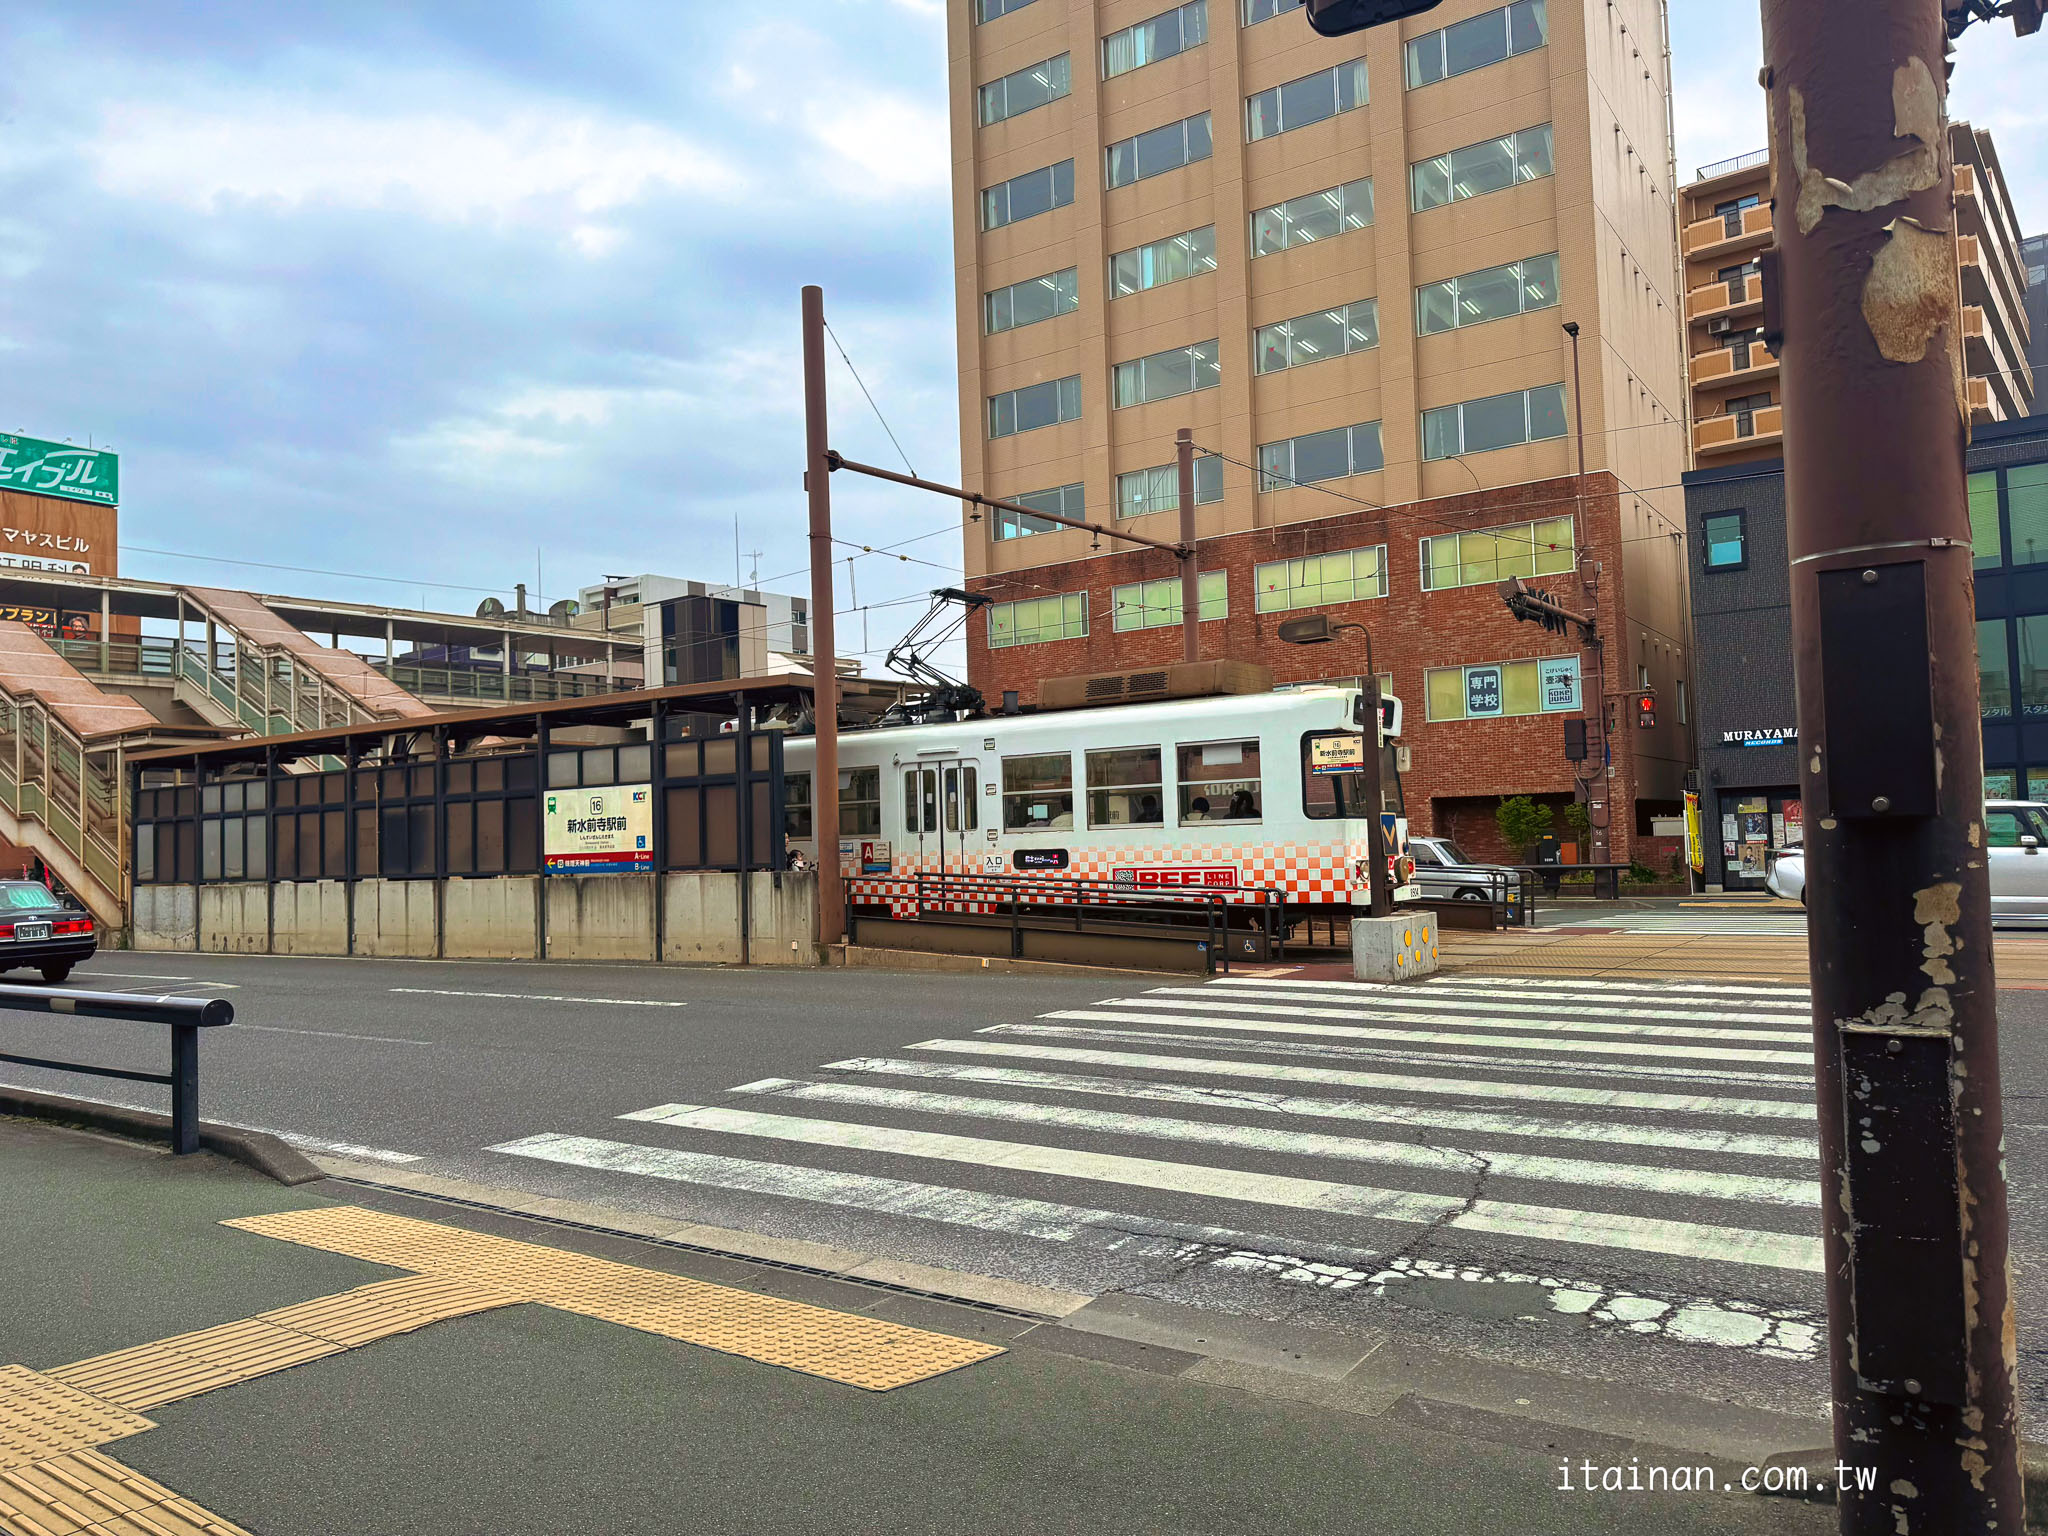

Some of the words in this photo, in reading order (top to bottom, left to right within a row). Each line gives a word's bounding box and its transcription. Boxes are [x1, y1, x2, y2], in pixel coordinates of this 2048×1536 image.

[2, 527, 90, 553] マヤスビル
[1470, 676, 1497, 689] 専門
[1471, 693, 1498, 708] 学校
[592, 800, 602, 812] 16
[567, 816, 627, 834] 新水前寺駅前
[634, 852, 650, 860] A-Line
[864, 846, 872, 860] A
[634, 863, 650, 871] B-Line
[986, 856, 1003, 866] 入口
